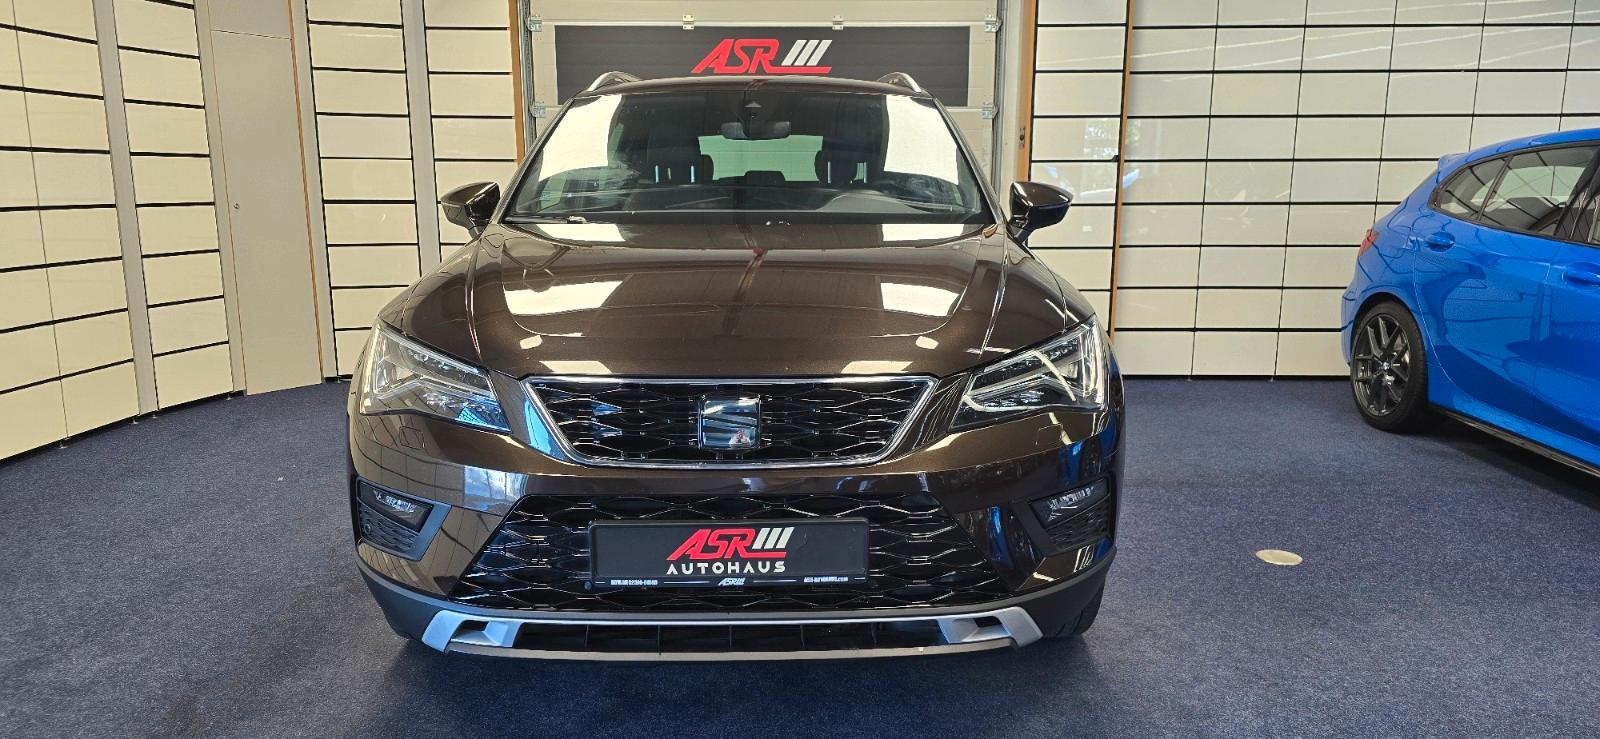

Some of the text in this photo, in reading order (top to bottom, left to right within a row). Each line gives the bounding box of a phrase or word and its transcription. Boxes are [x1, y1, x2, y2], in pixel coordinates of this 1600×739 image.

[691, 38, 832, 74] ASR
[667, 527, 787, 560] ASR
[666, 560, 787, 575] AUTOHAUS
